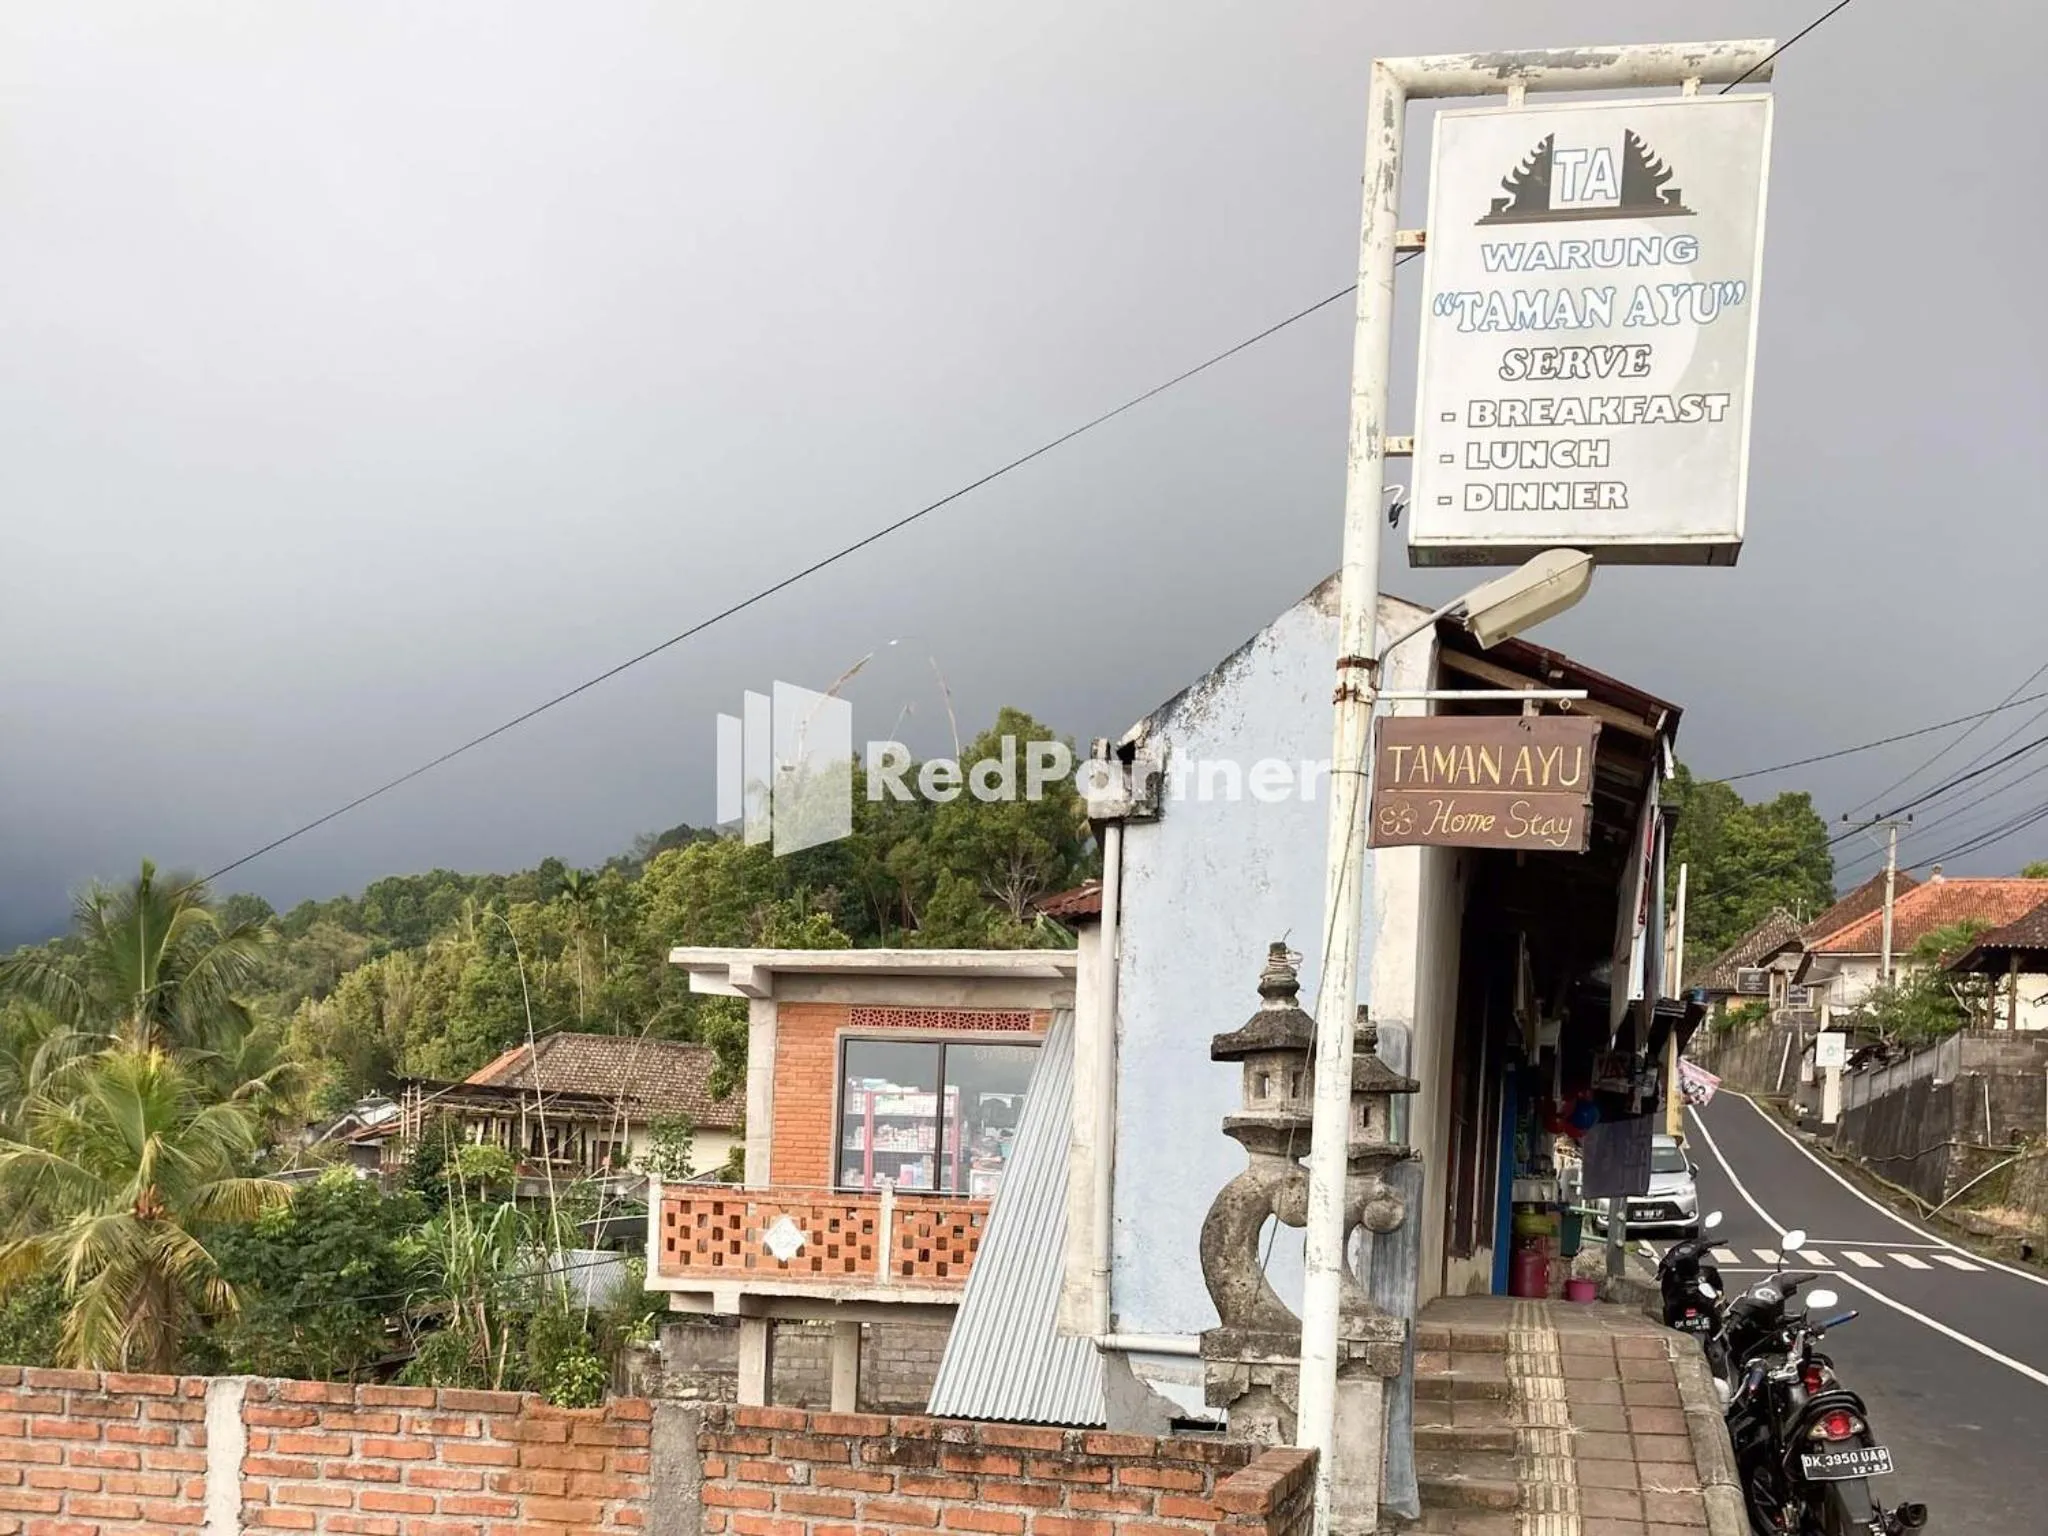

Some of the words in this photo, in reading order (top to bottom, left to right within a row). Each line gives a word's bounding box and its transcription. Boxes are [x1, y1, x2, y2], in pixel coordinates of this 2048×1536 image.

[1553, 148, 1619, 202] TA
[1481, 235, 1699, 272] WARUNG
[1499, 344, 1652, 381] SERVE
[1467, 393, 1730, 428] BREAKFAST
[1465, 439, 1610, 470] LUNCH
[1464, 482, 1629, 511] DINNER
[1387, 745, 1502, 785] TAMAN
[1509, 745, 1582, 786] AYU
[1422, 799, 1496, 836] Home
[1504, 800, 1573, 847] Stay
[1803, 1456, 1822, 1468] DK
[1825, 1452, 1858, 1466] 3950
